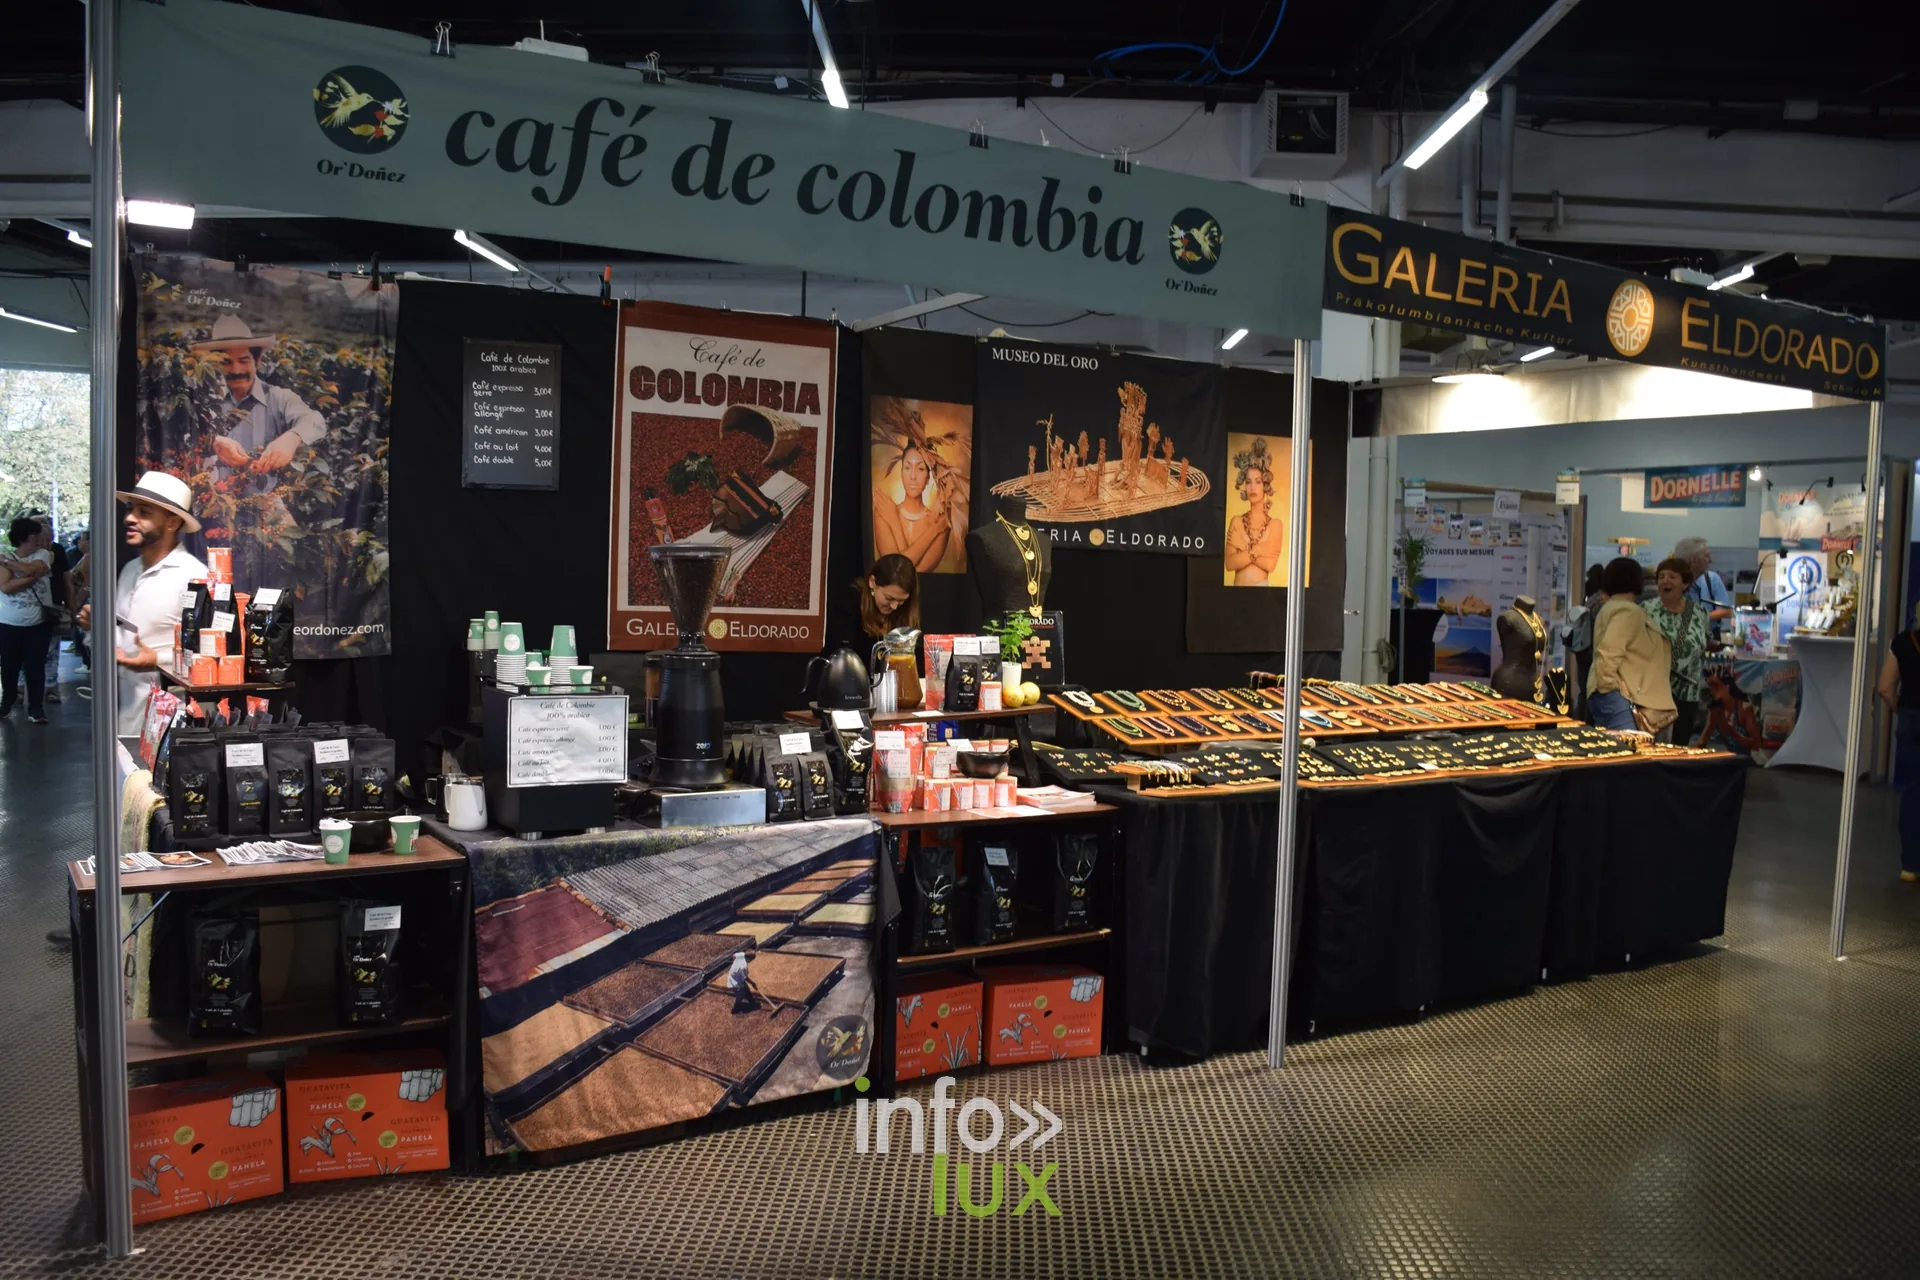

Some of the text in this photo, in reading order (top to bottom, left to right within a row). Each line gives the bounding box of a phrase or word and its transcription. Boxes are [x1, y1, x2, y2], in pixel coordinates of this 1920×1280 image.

[443, 96, 1147, 266] café de colombia
[1332, 221, 1573, 324] GALERIA
[1336, 291, 1575, 346] Präkolumbianische Kultur
[1681, 296, 1880, 380] ELDORADO
[481, 352, 550, 365] Café de Colombie
[689, 336, 766, 371] Café de
[992, 347, 1099, 370] MUSEO DEL ORO
[509, 365, 537, 375] arabica
[472, 380, 489, 391] Café
[492, 384, 523, 394] expresso
[629, 365, 821, 415] COLOMBIA
[474, 401, 491, 411] Café
[493, 404, 525, 413] expresso
[474, 425, 493, 435] Café
[495, 427, 528, 436] américain
[474, 441, 491, 450] Café
[505, 443, 519, 451] lait
[474, 455, 490, 464] Café
[492, 455, 514, 464] double
[1650, 470, 1741, 504] DORNELLE
[1106, 529, 1205, 549] ELDORADO
[1425, 548, 1495, 557] VOYAGES SUR MESURE
[730, 620, 810, 639] ELDORADO
[899, 1048, 921, 1056] PANELA
[310, 1103, 343, 1111] PANELA
[390, 1115, 440, 1126] GUATAVITA
[133, 1137, 170, 1149] PANELA
[401, 1134, 433, 1143] PANELA
[232, 1160, 266, 1172] PANELA
